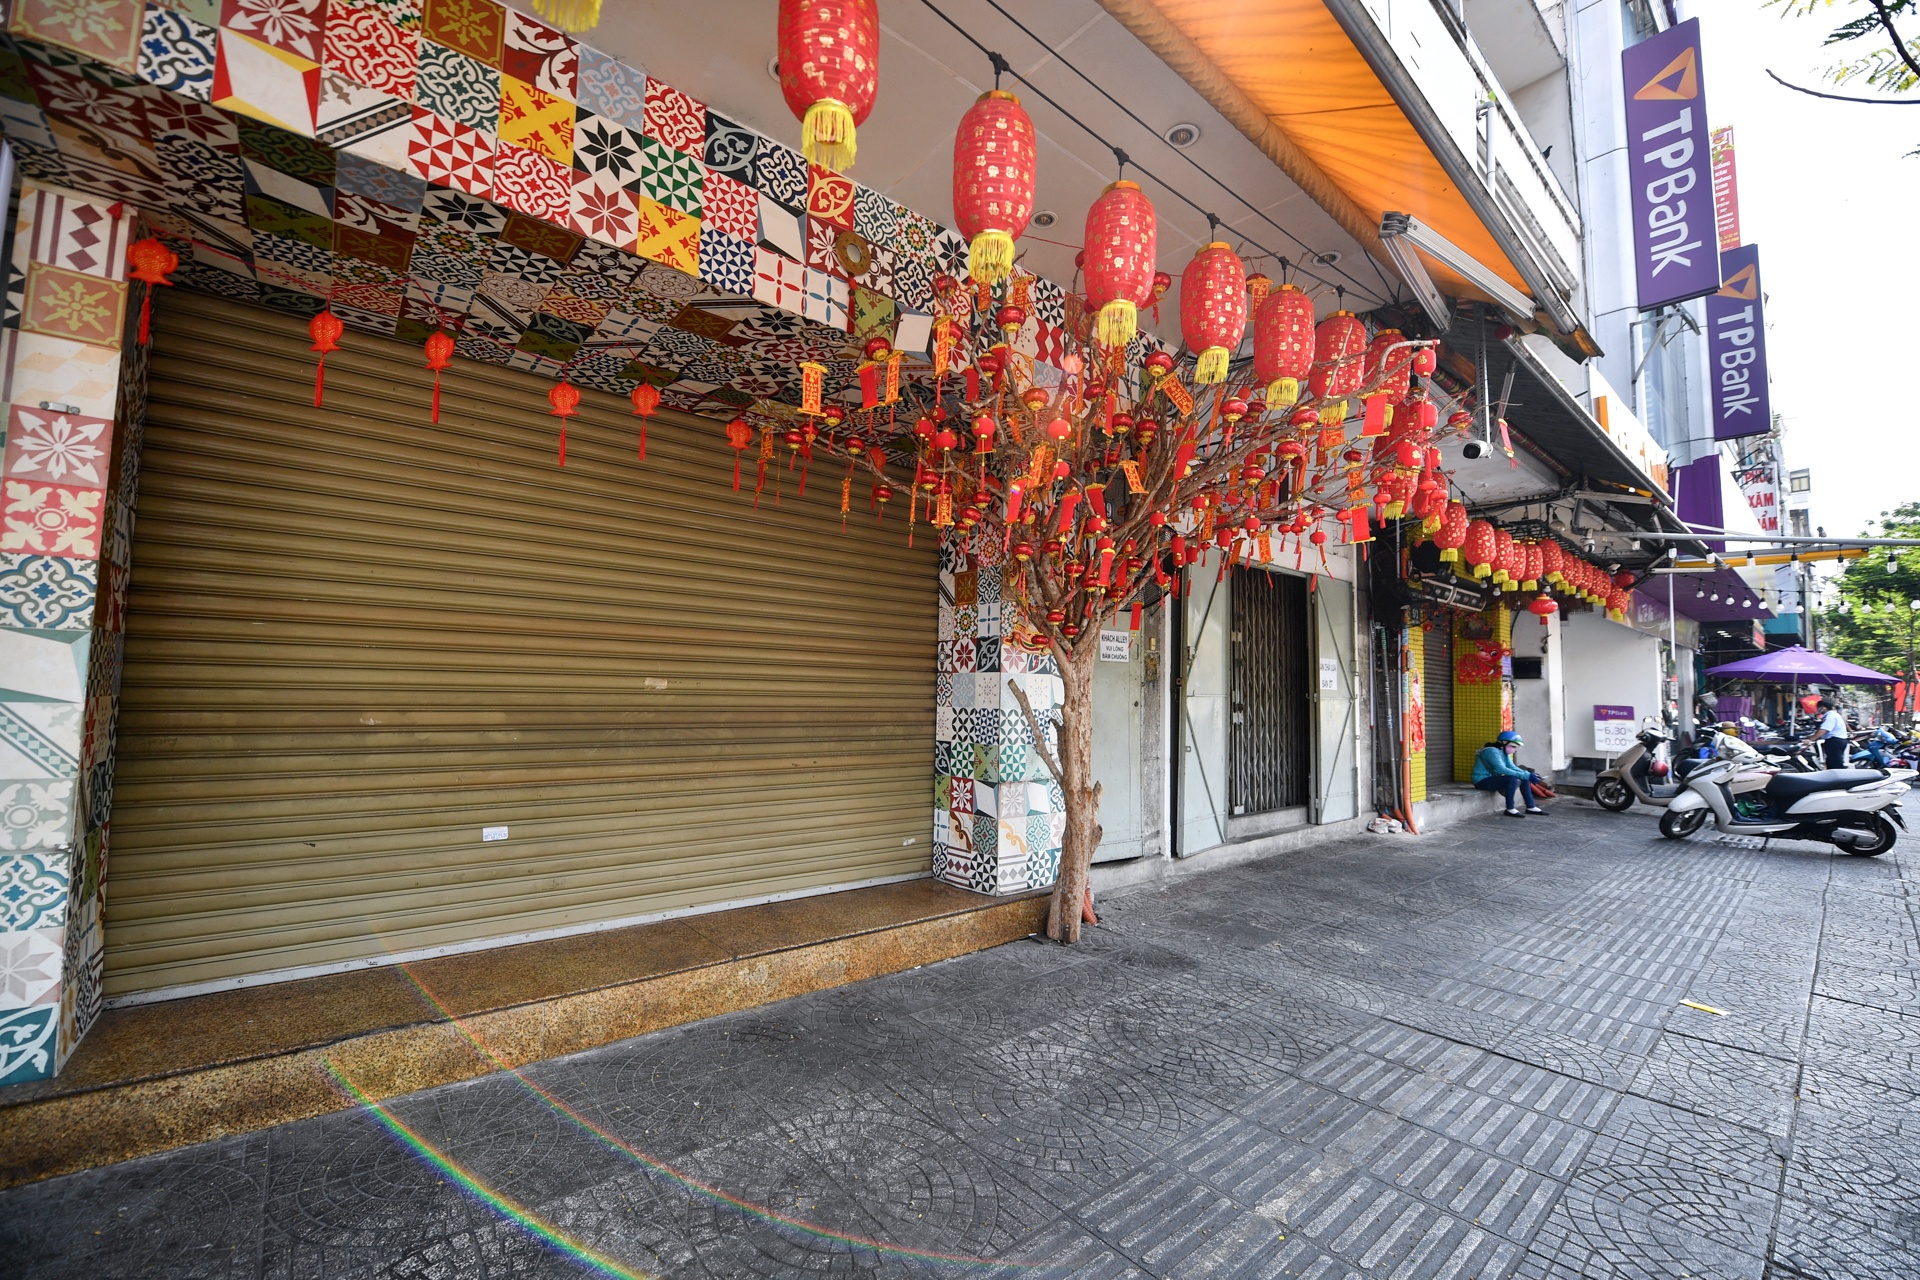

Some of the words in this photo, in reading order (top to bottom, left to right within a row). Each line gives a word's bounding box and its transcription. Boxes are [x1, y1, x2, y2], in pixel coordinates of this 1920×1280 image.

[1642, 106, 1702, 278] TPBank
[1717, 304, 1760, 419] TPBank
[1747, 490, 1774, 508] XĂM
